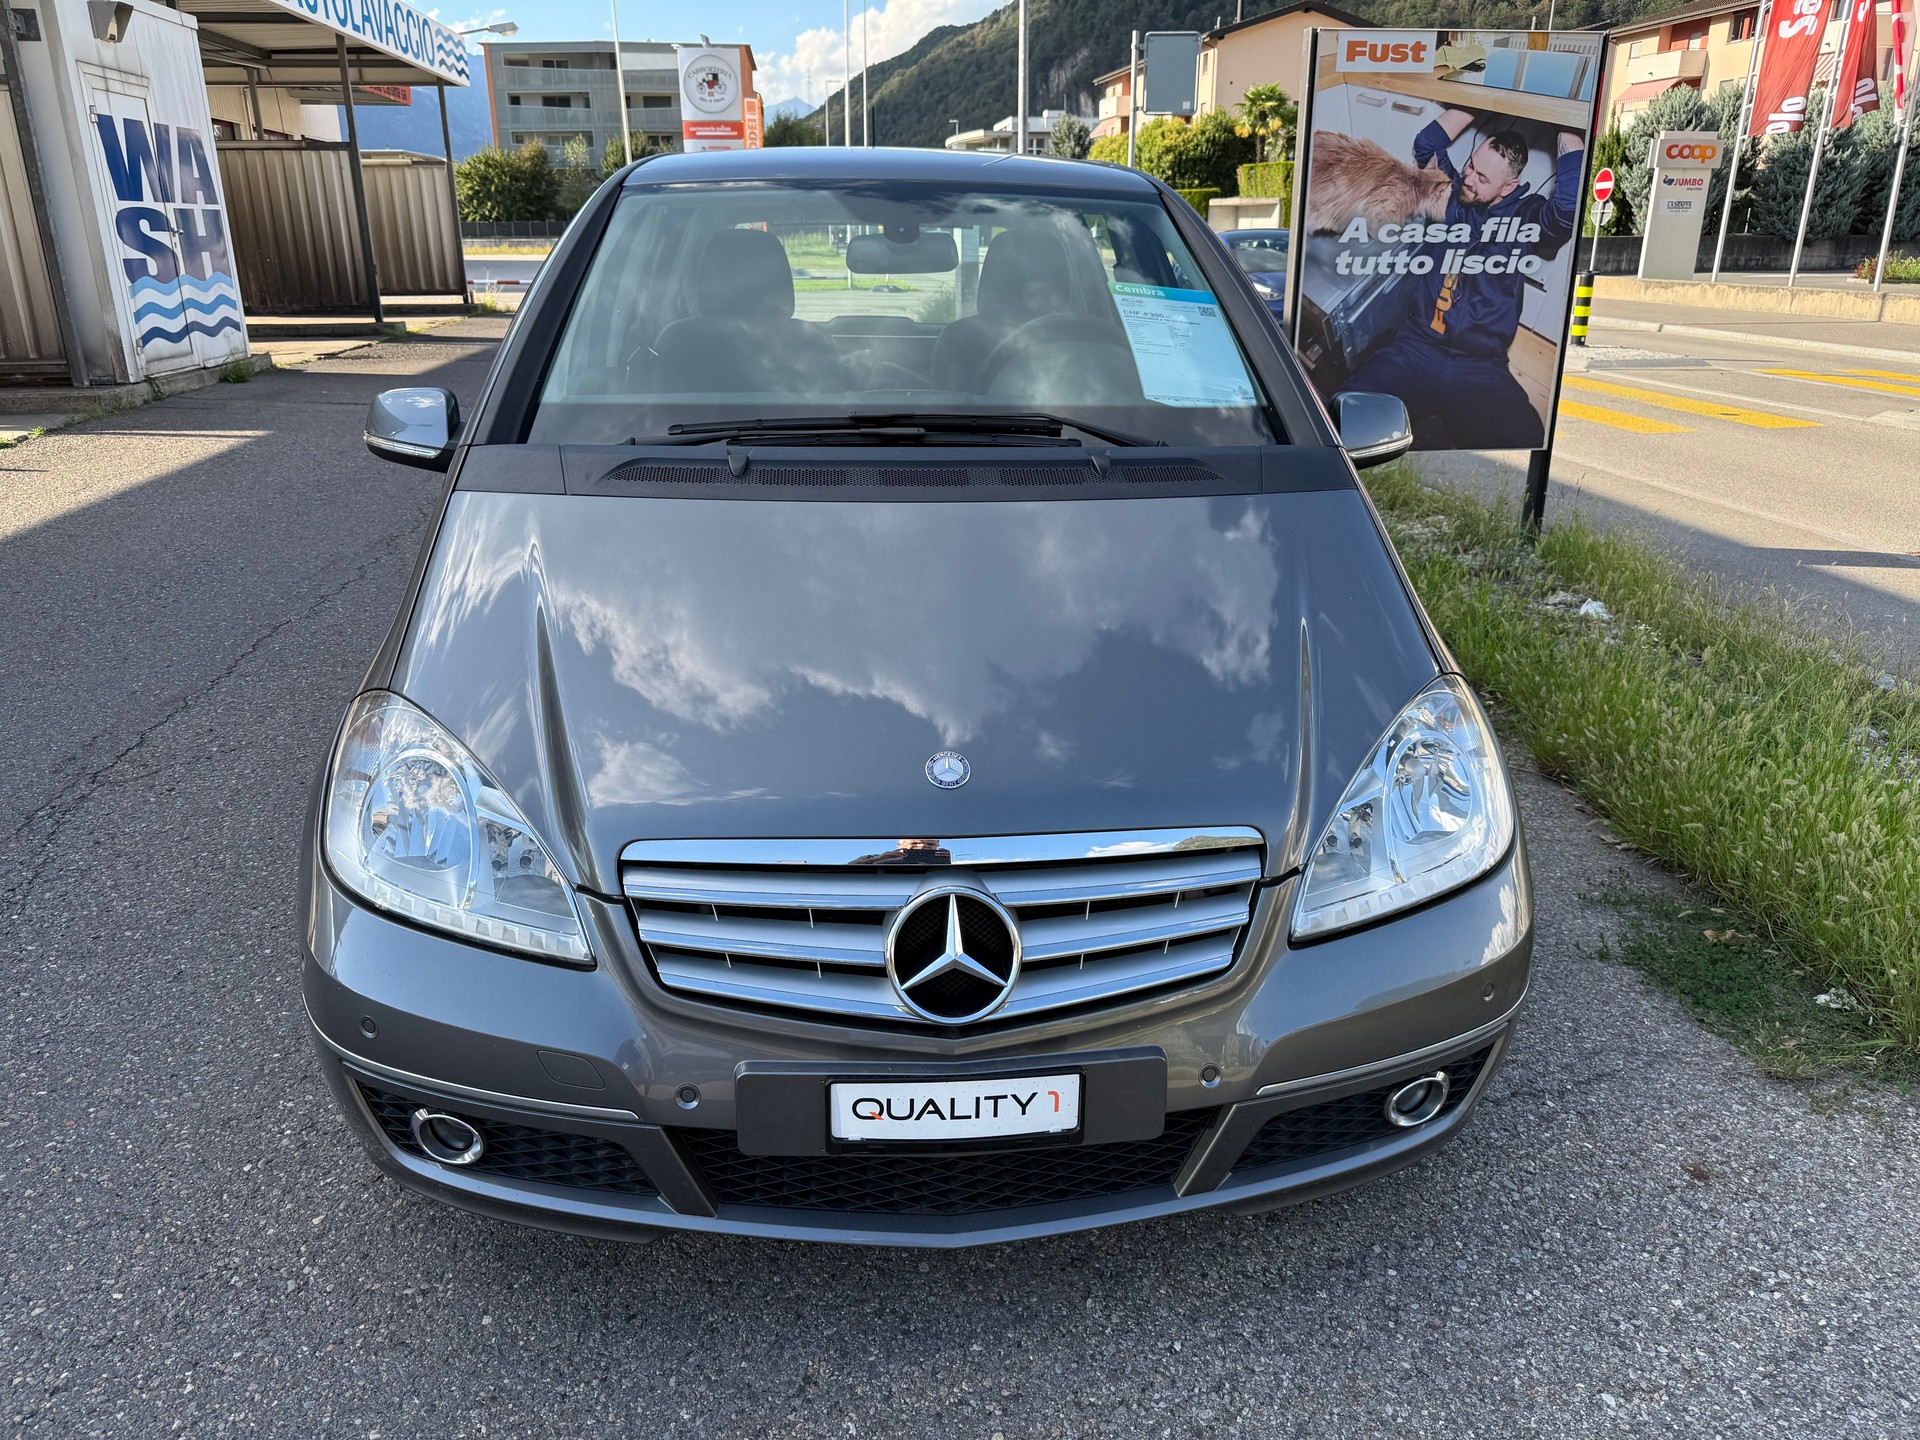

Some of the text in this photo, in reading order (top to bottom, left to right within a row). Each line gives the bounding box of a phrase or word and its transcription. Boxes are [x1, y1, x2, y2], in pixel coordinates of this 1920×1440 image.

[1346, 40, 1427, 63] Fust
[1666, 143, 1717, 164] coop
[1673, 178, 1704, 186] JUMBO
[1338, 216, 1541, 243] A casa fila
[1335, 249, 1541, 275] tutto liscio
[1115, 284, 1165, 297] Cembra
[851, 1091, 1038, 1121] QUALITY
